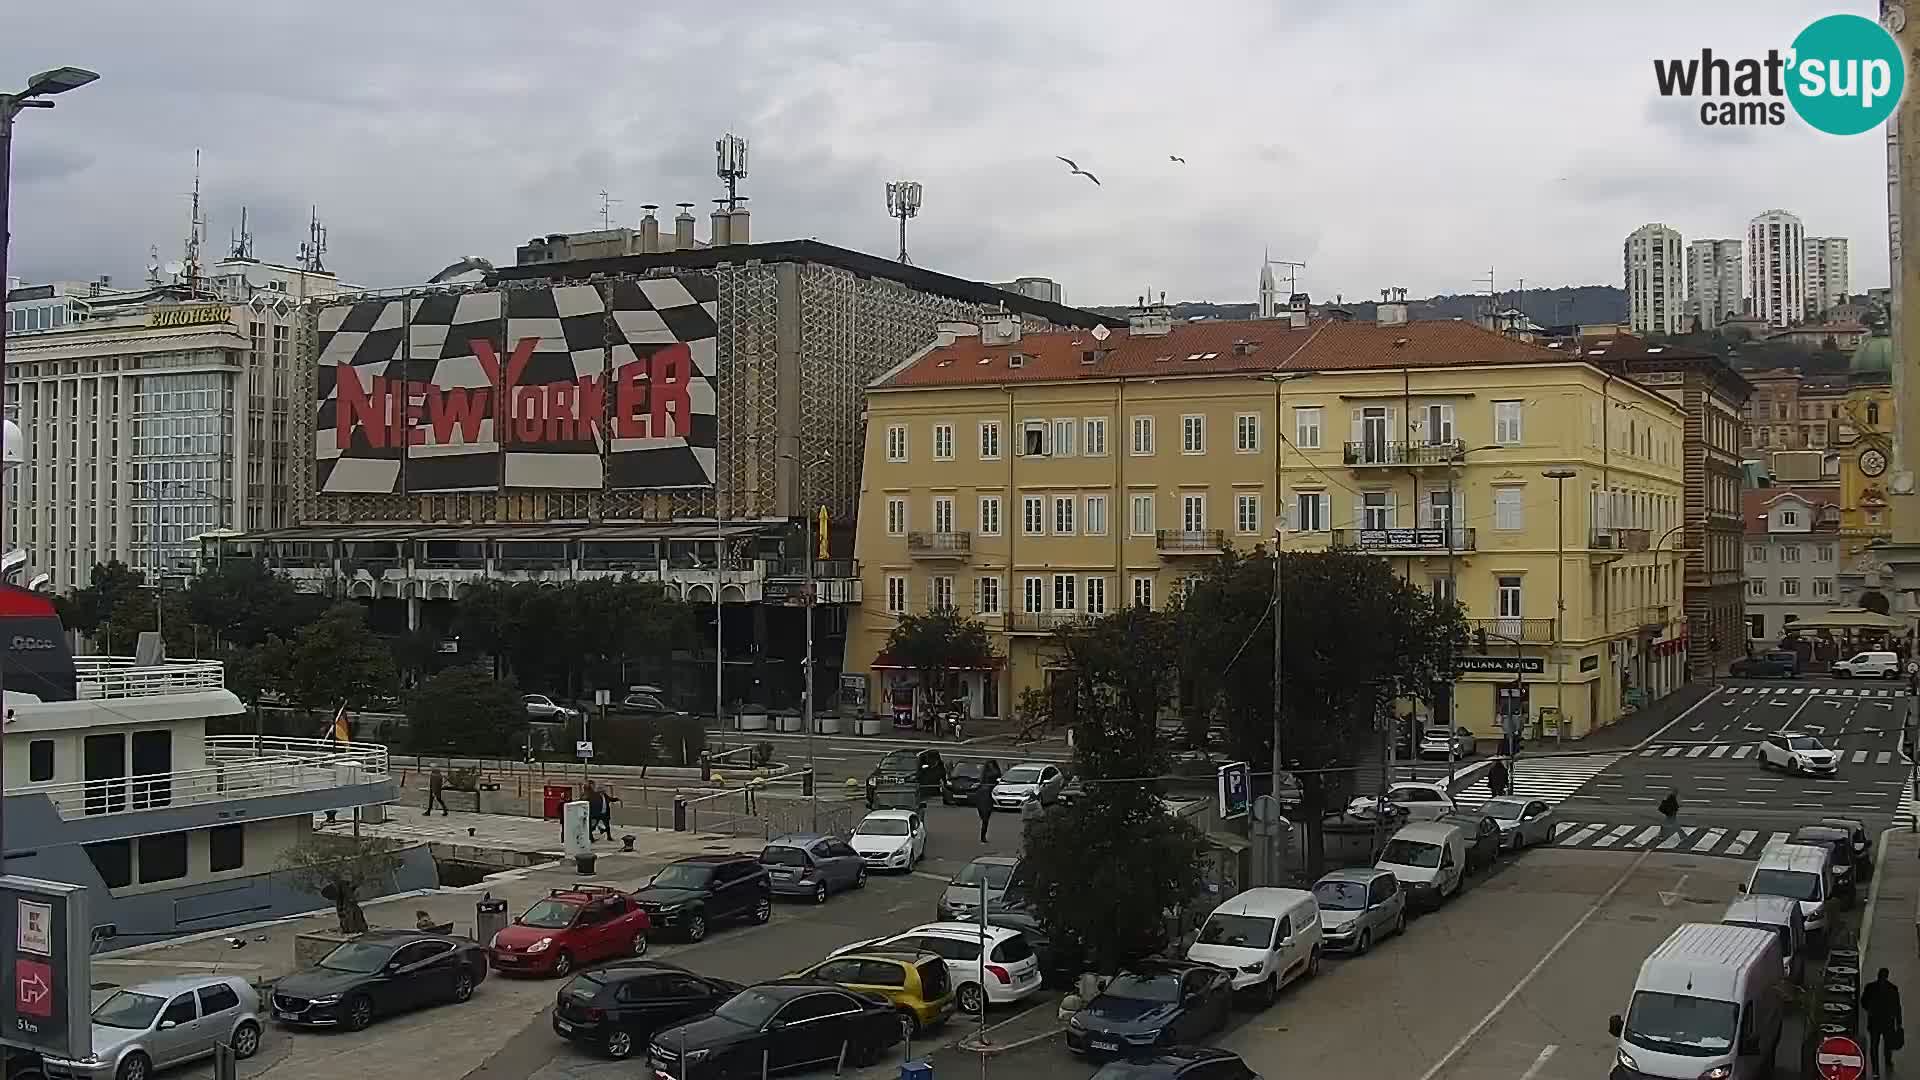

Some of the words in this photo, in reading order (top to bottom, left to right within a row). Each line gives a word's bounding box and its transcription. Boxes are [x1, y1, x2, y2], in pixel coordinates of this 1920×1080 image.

[336, 360, 488, 449] NEW
[468, 337, 692, 443] YORKER
[17, 1018, 24, 1030] 5
[25, 1020, 38, 1033] km
